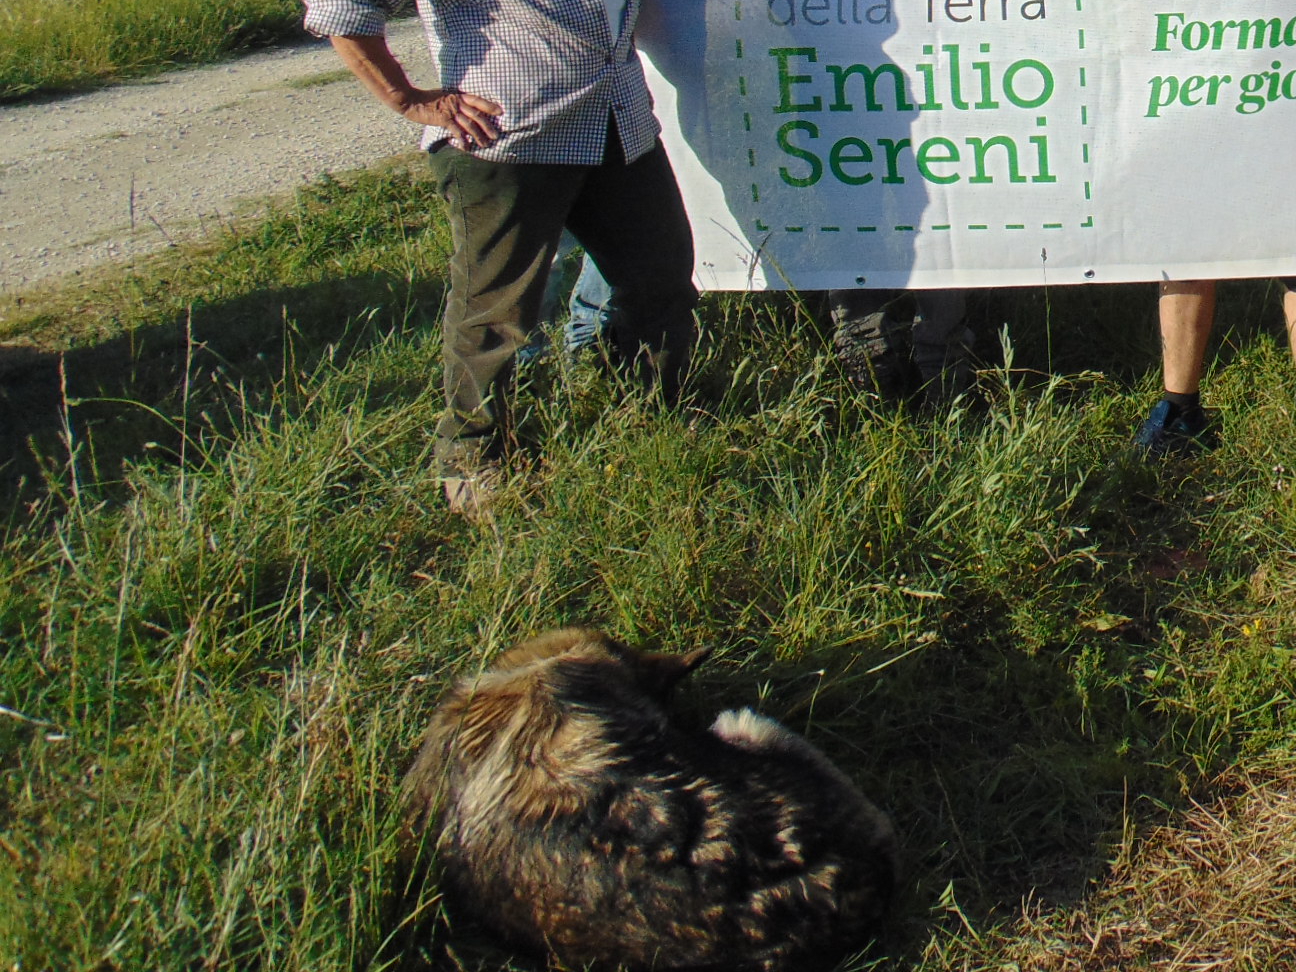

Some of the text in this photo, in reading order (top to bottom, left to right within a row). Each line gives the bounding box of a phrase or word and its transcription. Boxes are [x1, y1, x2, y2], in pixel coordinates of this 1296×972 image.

[769, 43, 1054, 113] Emilio
[1144, 73, 1232, 117] per
[776, 116, 1056, 188] Sereni
